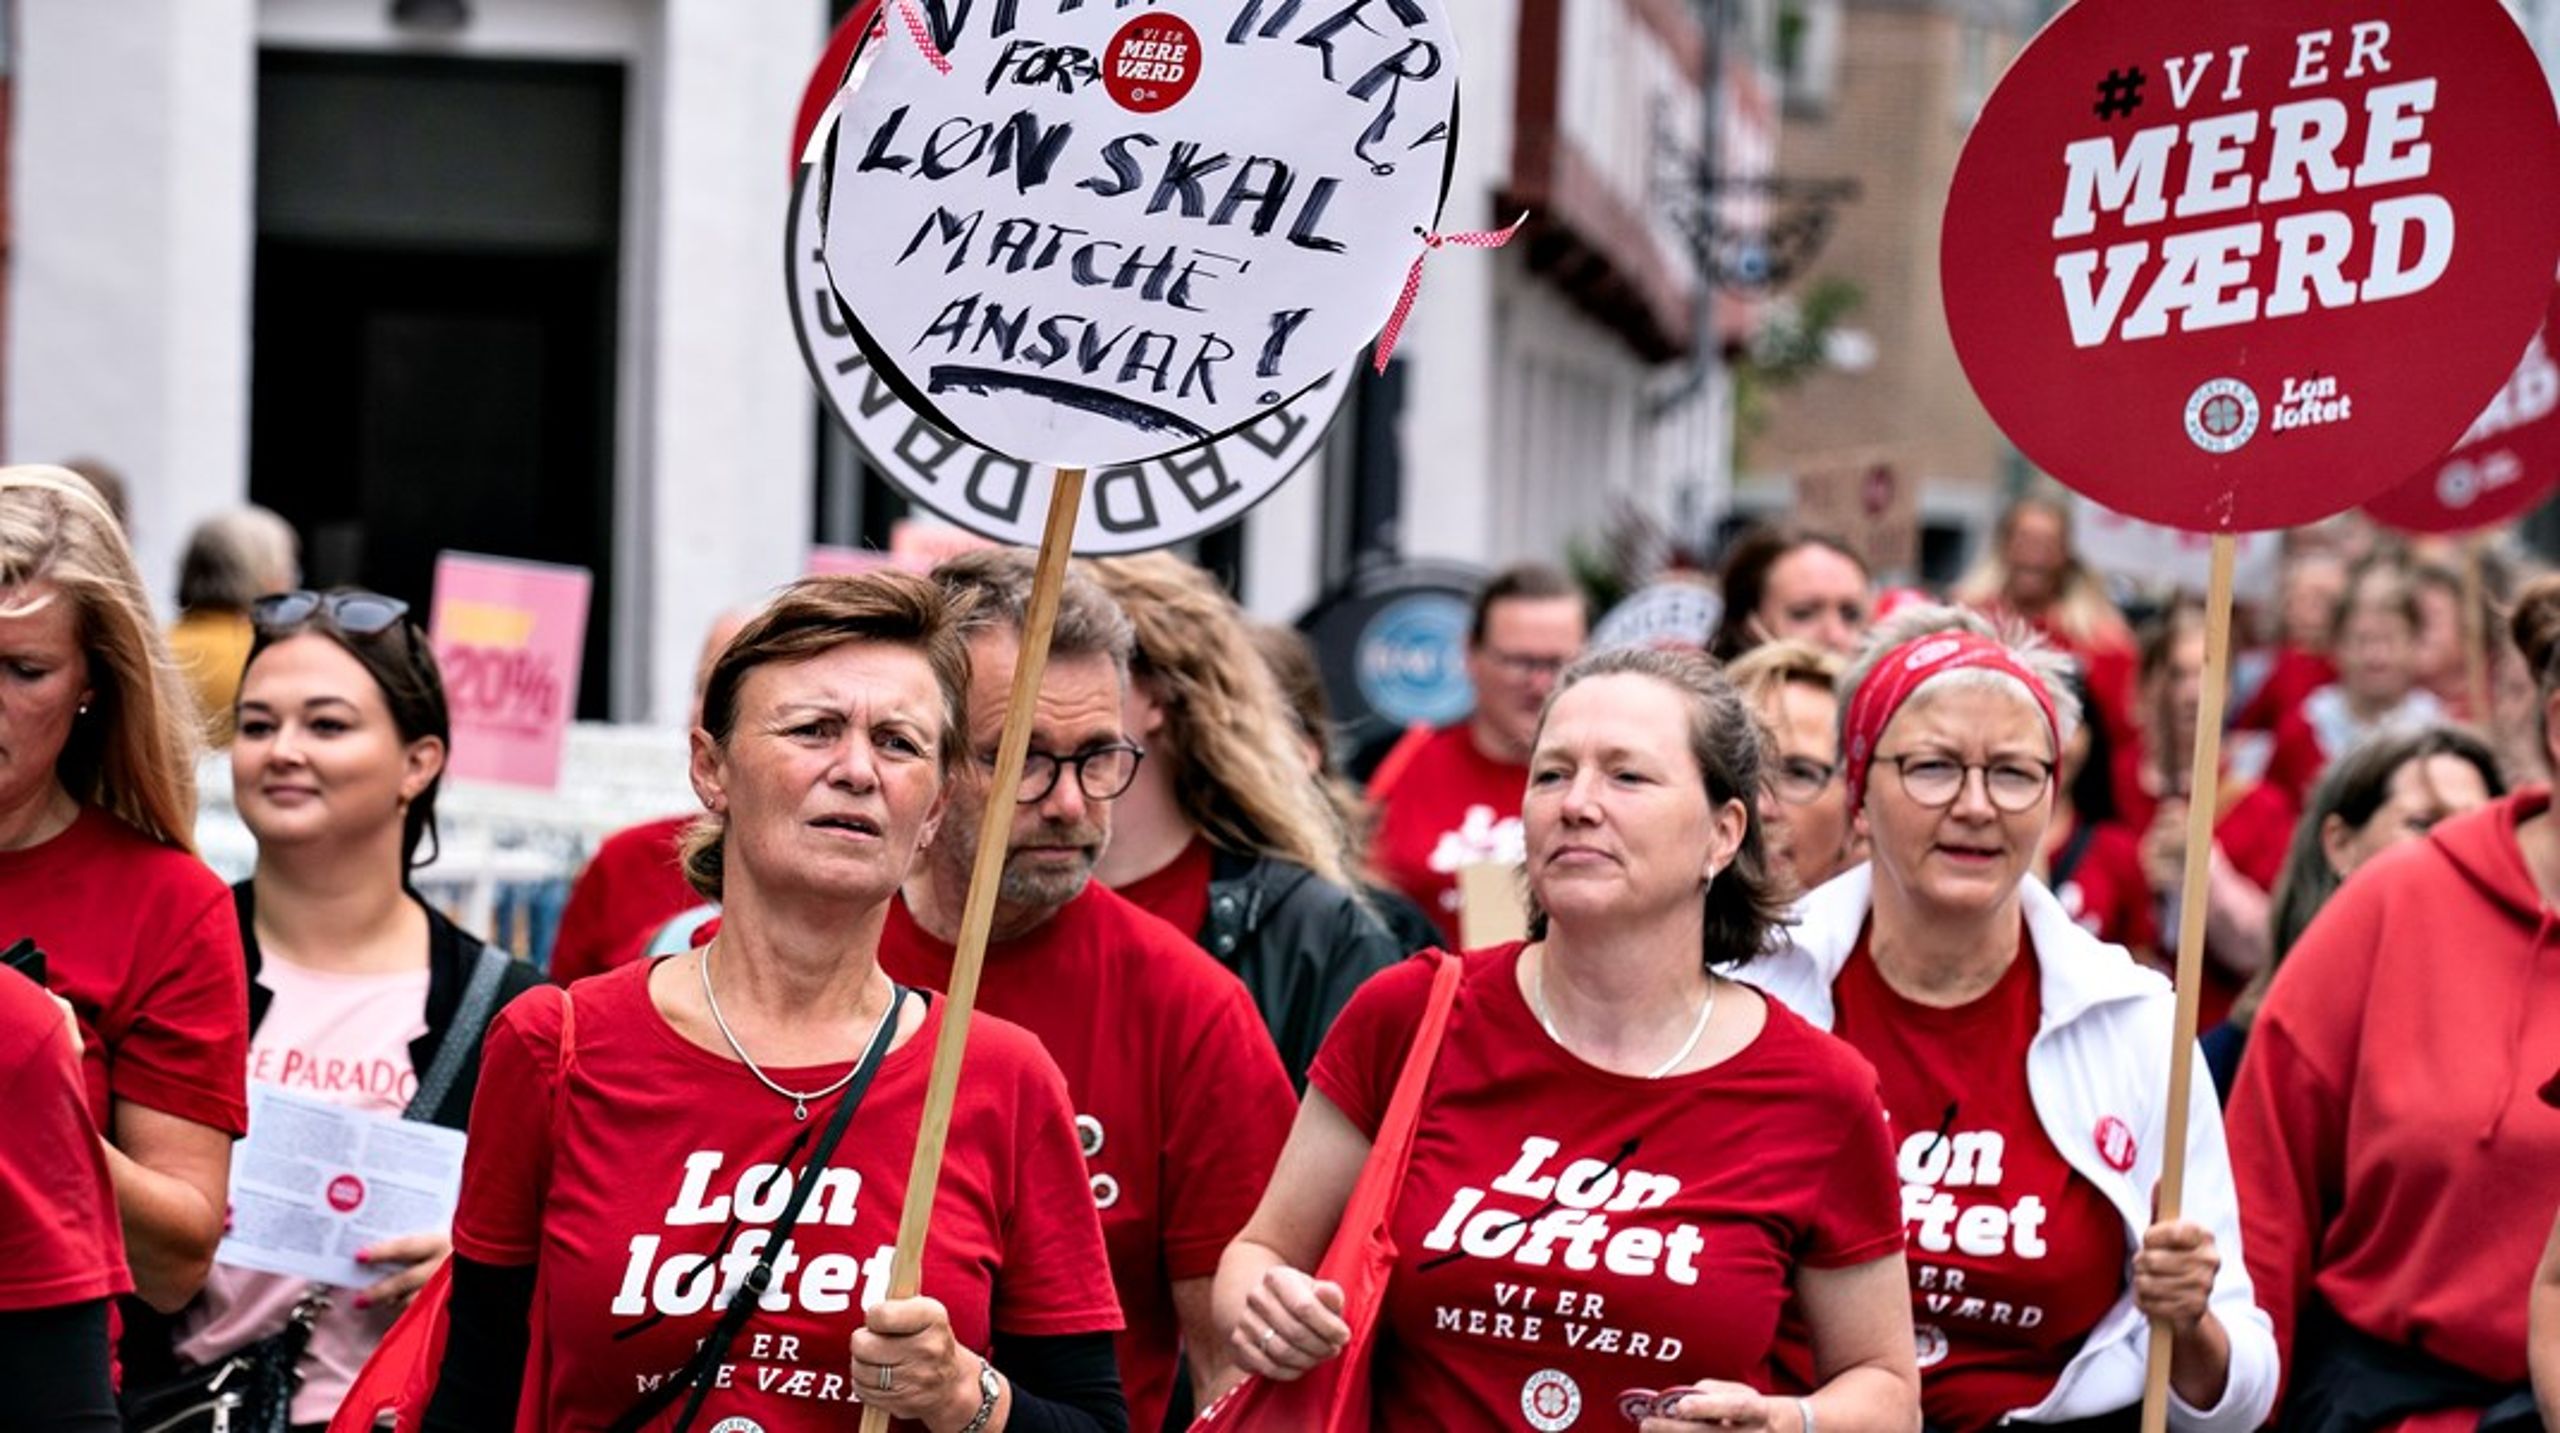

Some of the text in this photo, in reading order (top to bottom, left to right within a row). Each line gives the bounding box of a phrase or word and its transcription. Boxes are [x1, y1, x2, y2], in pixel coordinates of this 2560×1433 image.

[1116, 59, 1185, 83] VÆRD
[1119, 39, 1188, 63] MERE
[2289, 20, 2392, 88] ER
[857, 105, 1347, 253] LØN SKAL
[2052, 77, 2438, 240] MERE
[2053, 193, 2456, 349] VÆRD
[1901, 1183, 2048, 1260] ftet
[1494, 1281, 1606, 1320] VI ER
[1917, 1264, 1966, 1291] ER
[1435, 1306, 1684, 1363] MERE VÆRD
[1926, 1293, 2044, 1328] VÆRD
[750, 1333, 801, 1362] ER
